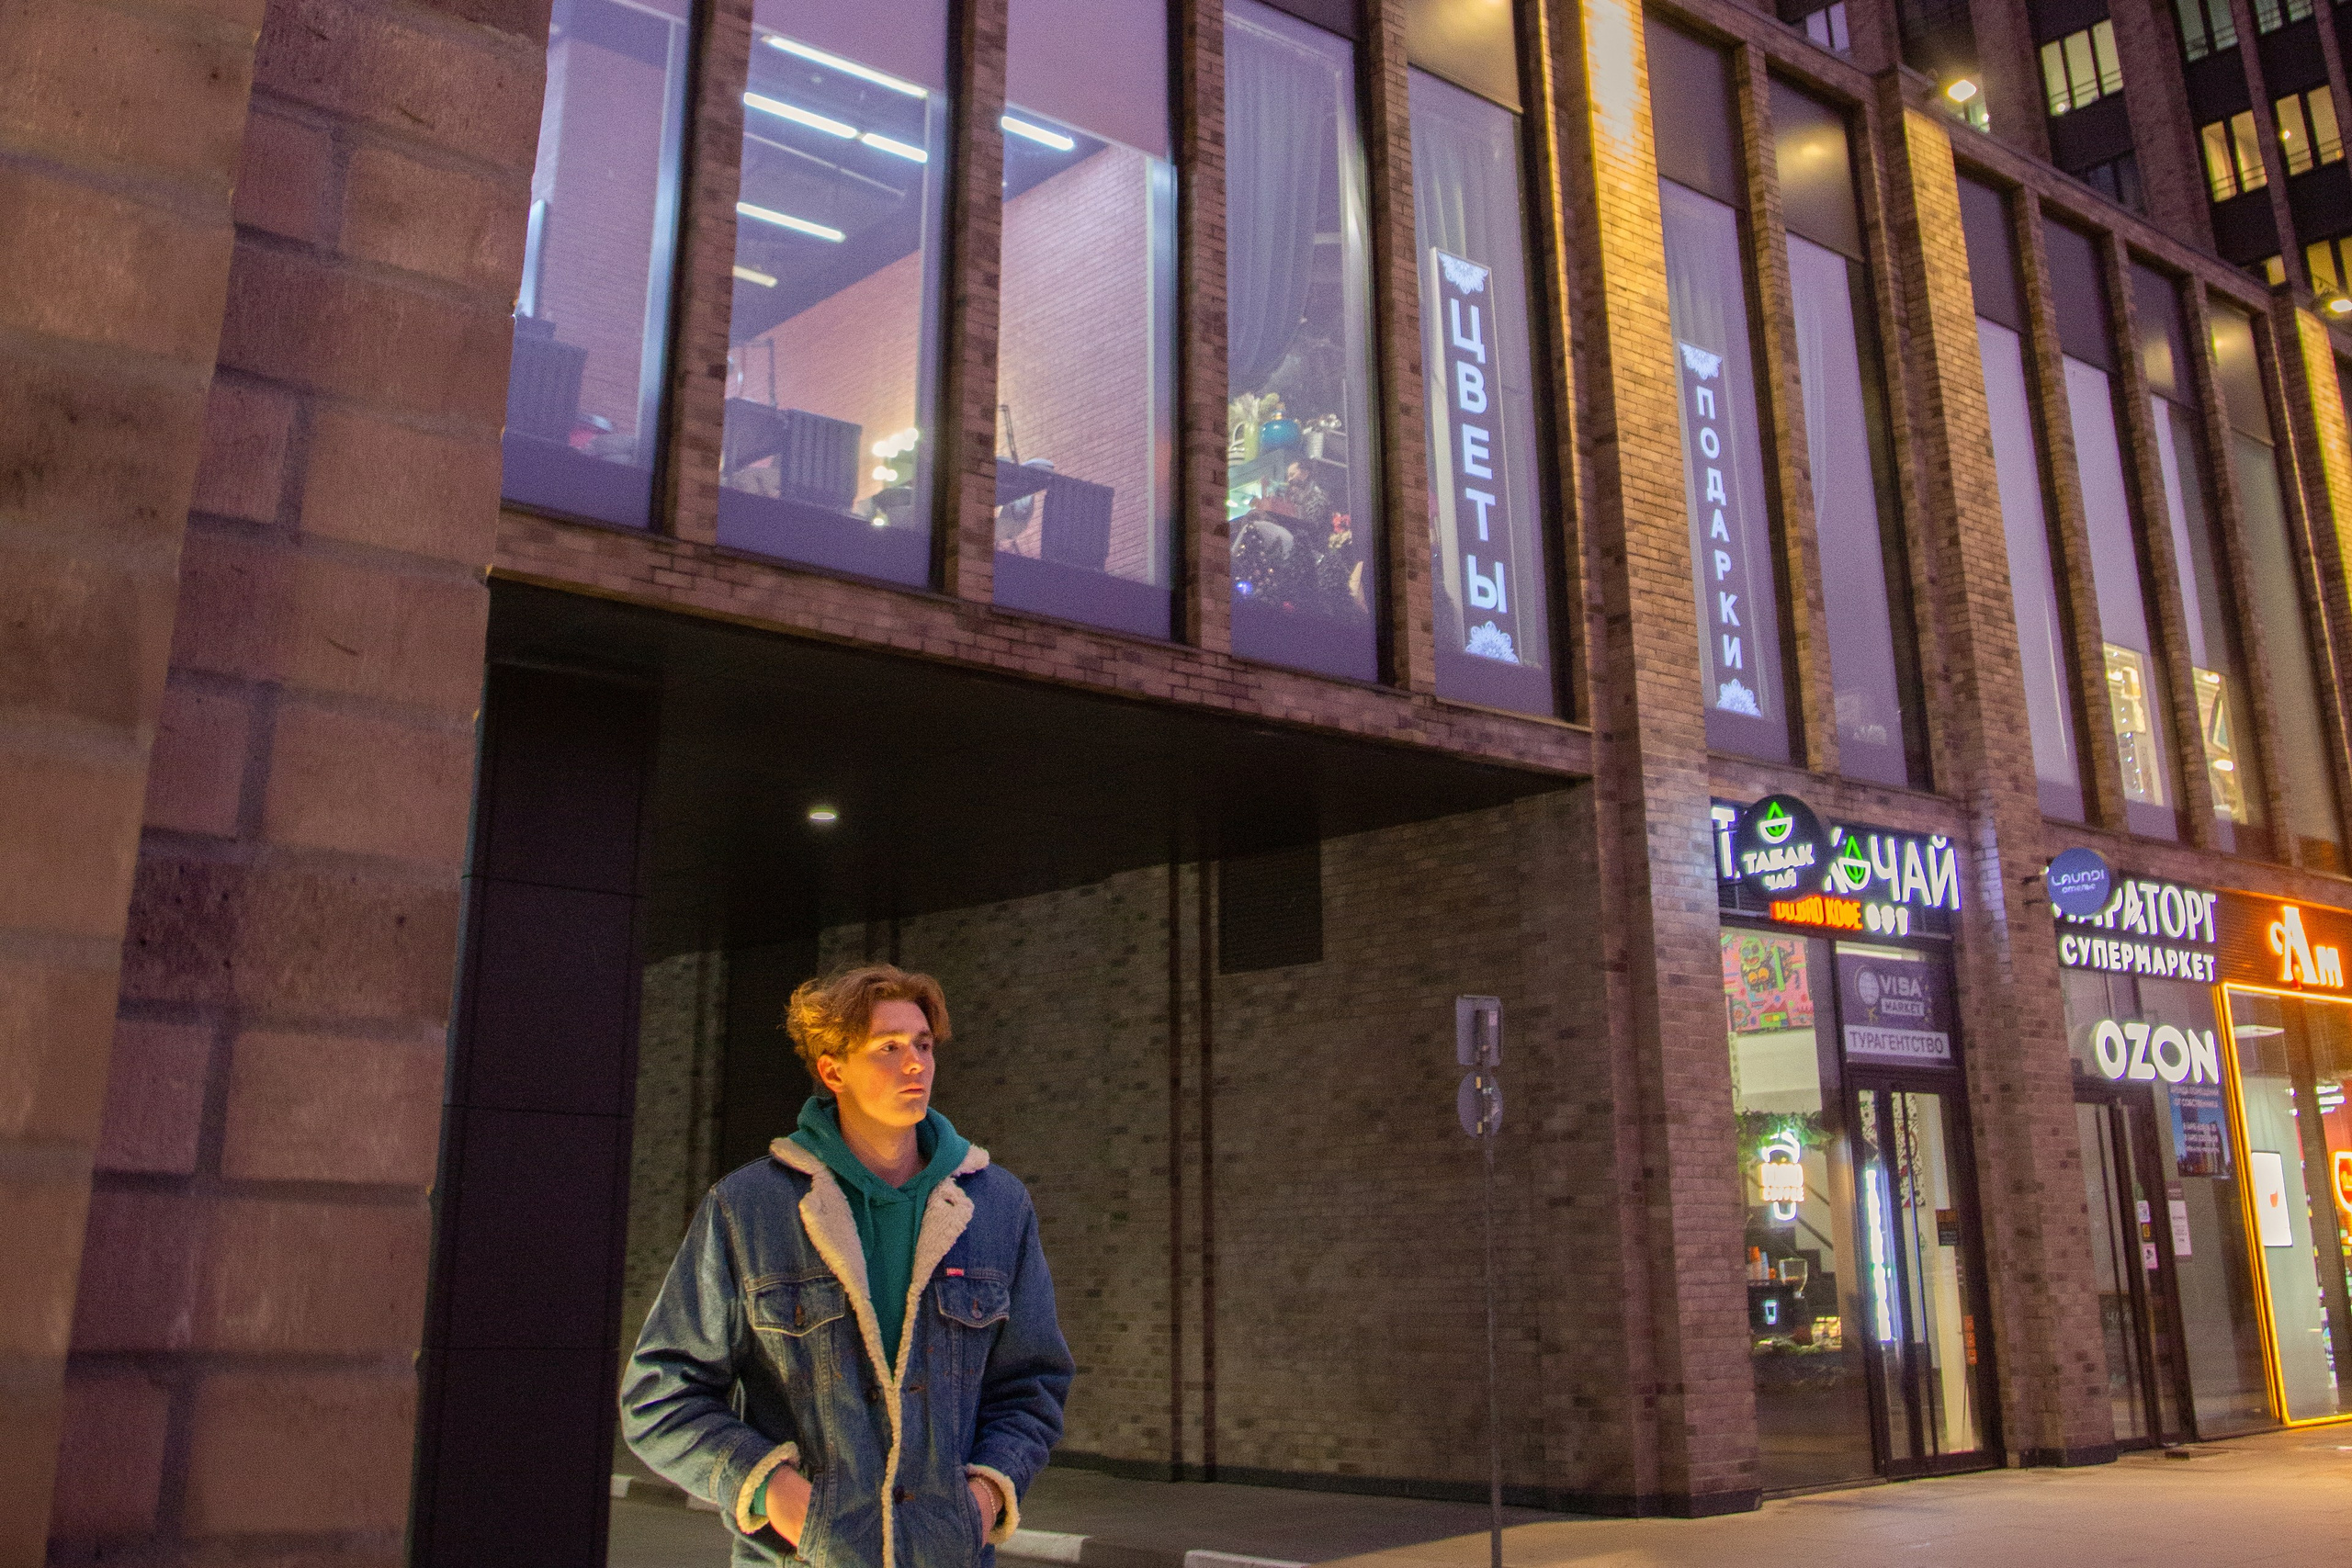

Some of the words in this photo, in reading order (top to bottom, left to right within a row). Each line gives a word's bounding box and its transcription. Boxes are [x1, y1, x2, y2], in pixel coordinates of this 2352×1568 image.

[1450, 297, 1508, 615] ЦВЕТЫ
[1695, 386, 1743, 670] ПОДАРКИ
[1743, 842, 1815, 874] ТАБАК
[1763, 867, 1797, 891] ЧАЙ
[1869, 834, 1961, 910] ЧАЙ
[2059, 934, 2215, 983] СУПЕРМАРКЕТ
[1879, 974, 1923, 998] VISA
[1849, 1031, 1944, 1055] ТУРАГЕНТСТВО
[2095, 1020, 2221, 1085] OZON
